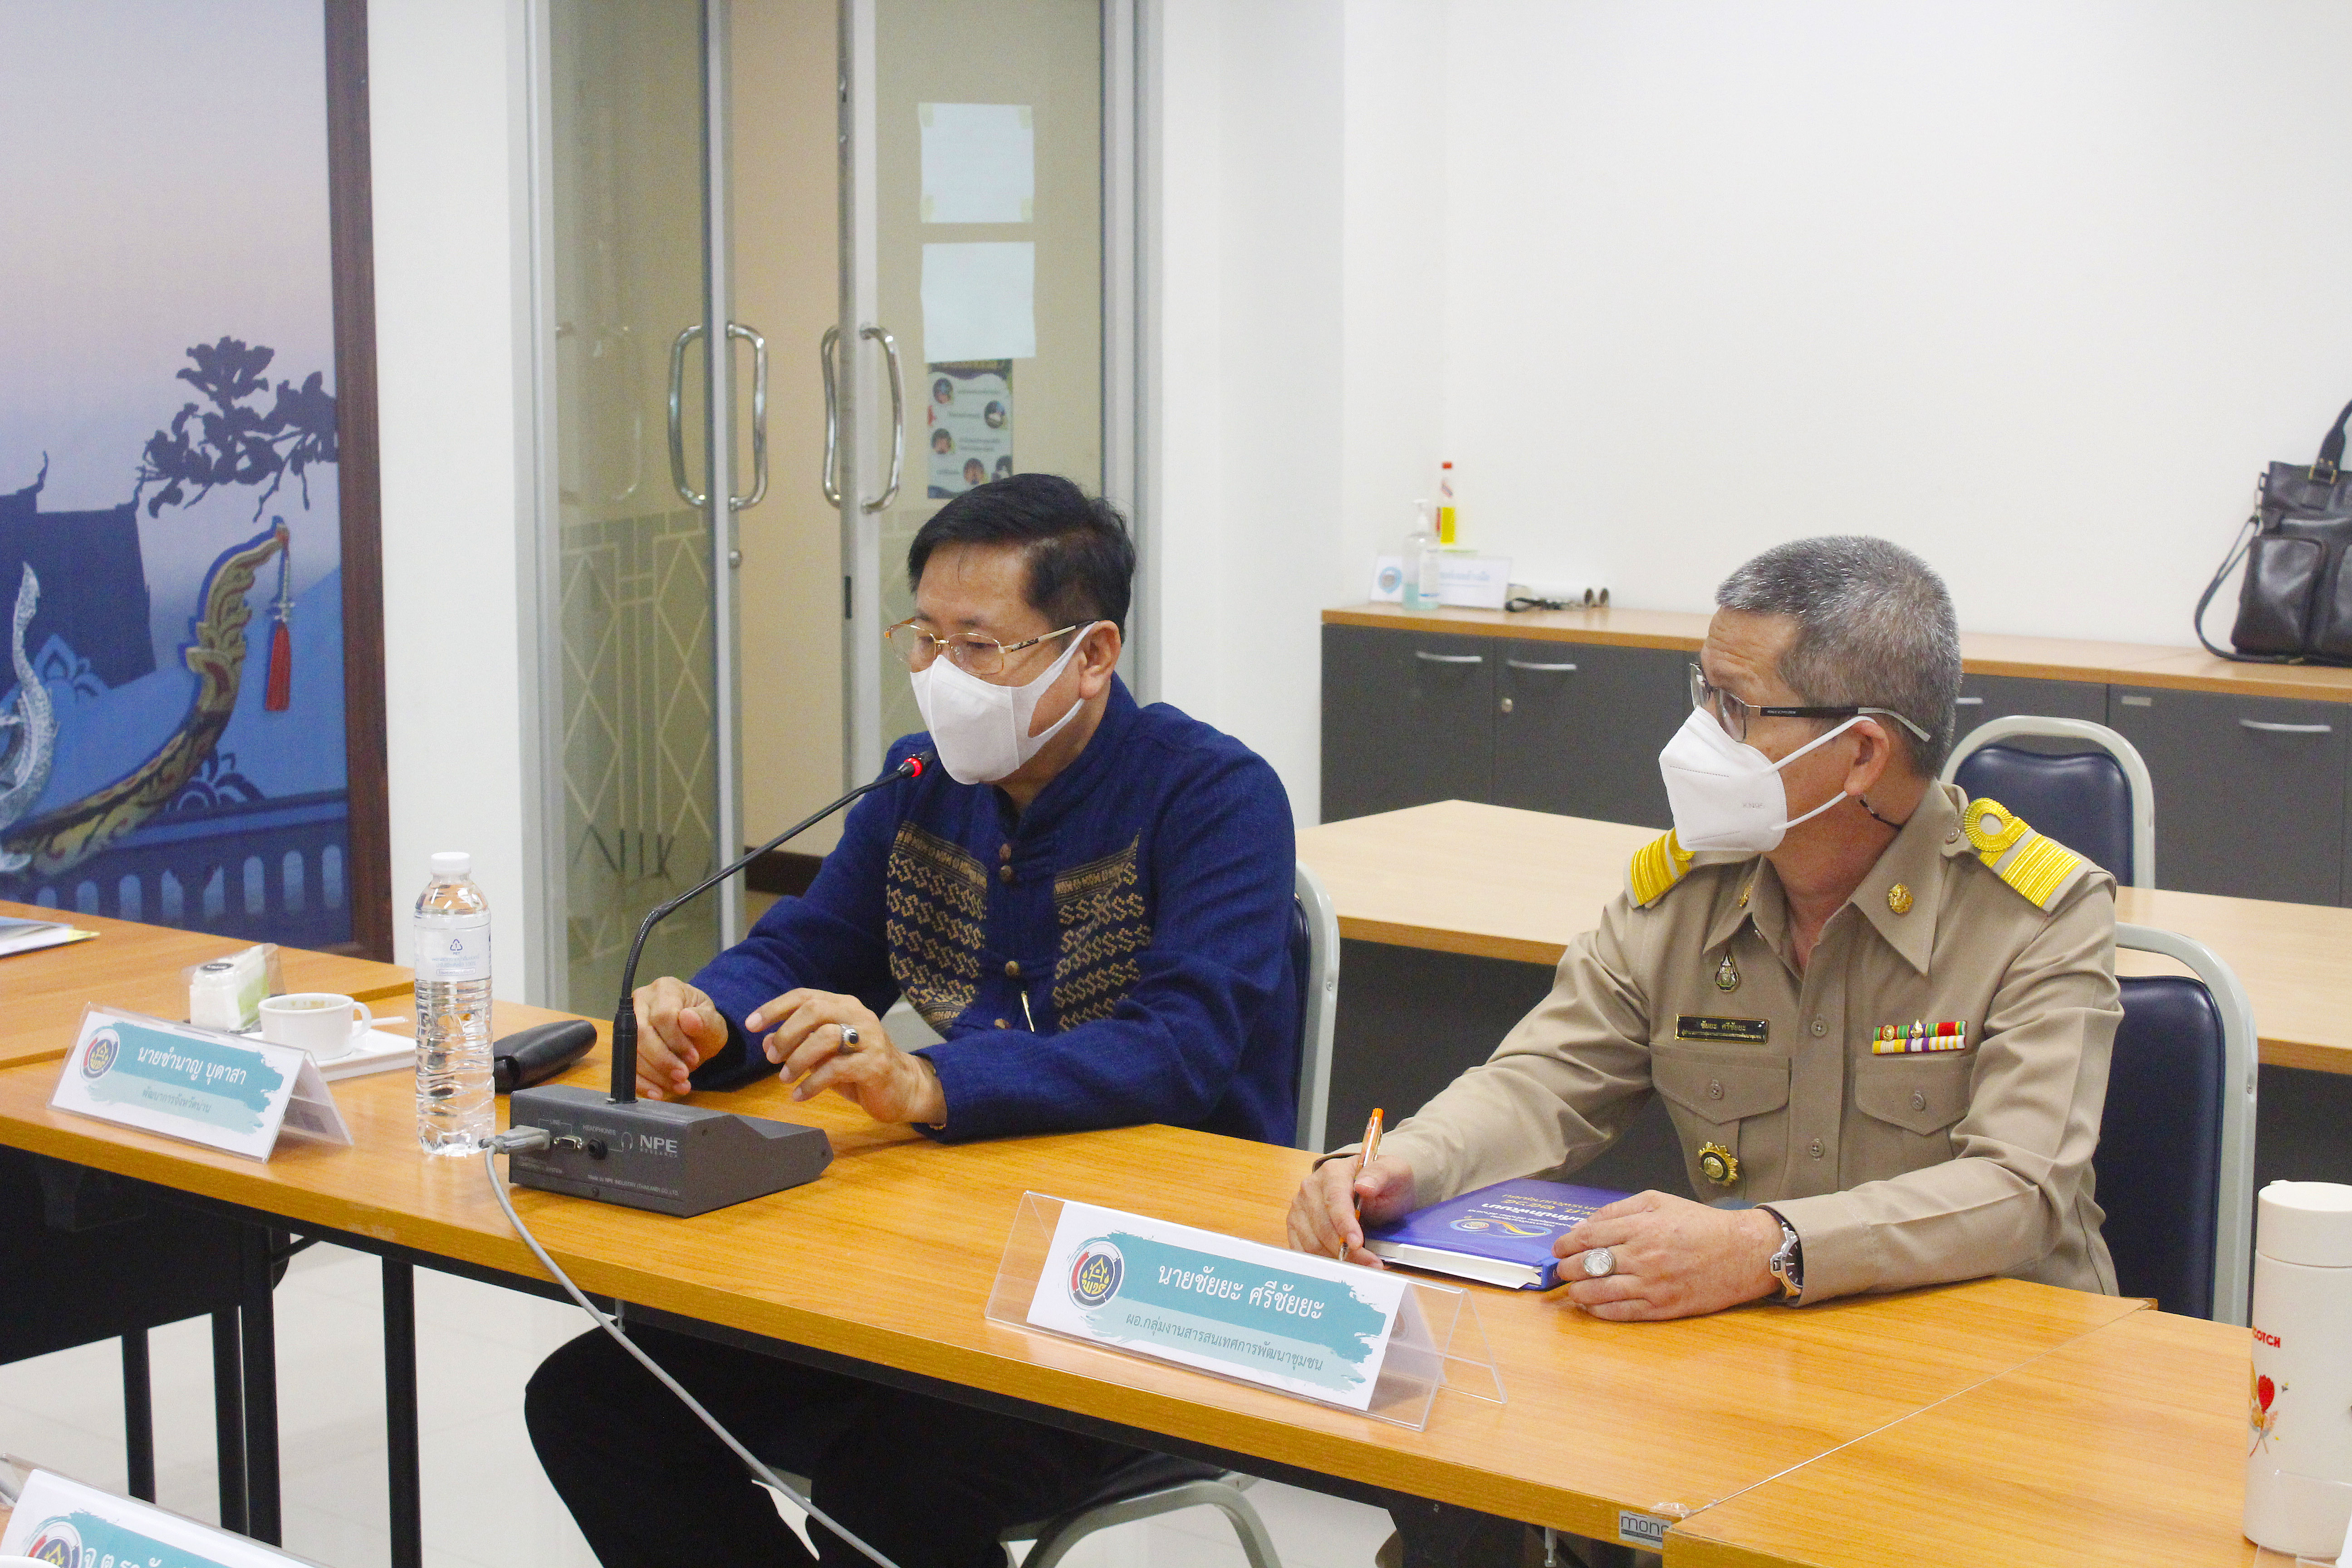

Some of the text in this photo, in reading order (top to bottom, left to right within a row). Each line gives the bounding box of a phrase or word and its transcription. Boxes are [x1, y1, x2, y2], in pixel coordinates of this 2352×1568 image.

[137, 1046, 247, 1085] นายชำนาญ บุดาสา
[583, 1125, 617, 1136] HEADPHONES
[640, 1134, 678, 1153] NPE
[1158, 1265, 1325, 1319] นายชัยยะ ศรีชัยยะ
[1126, 1313, 1323, 1371] ผอ.กลุ่มงานสารสนเทศการพัฒนาชุมชน
